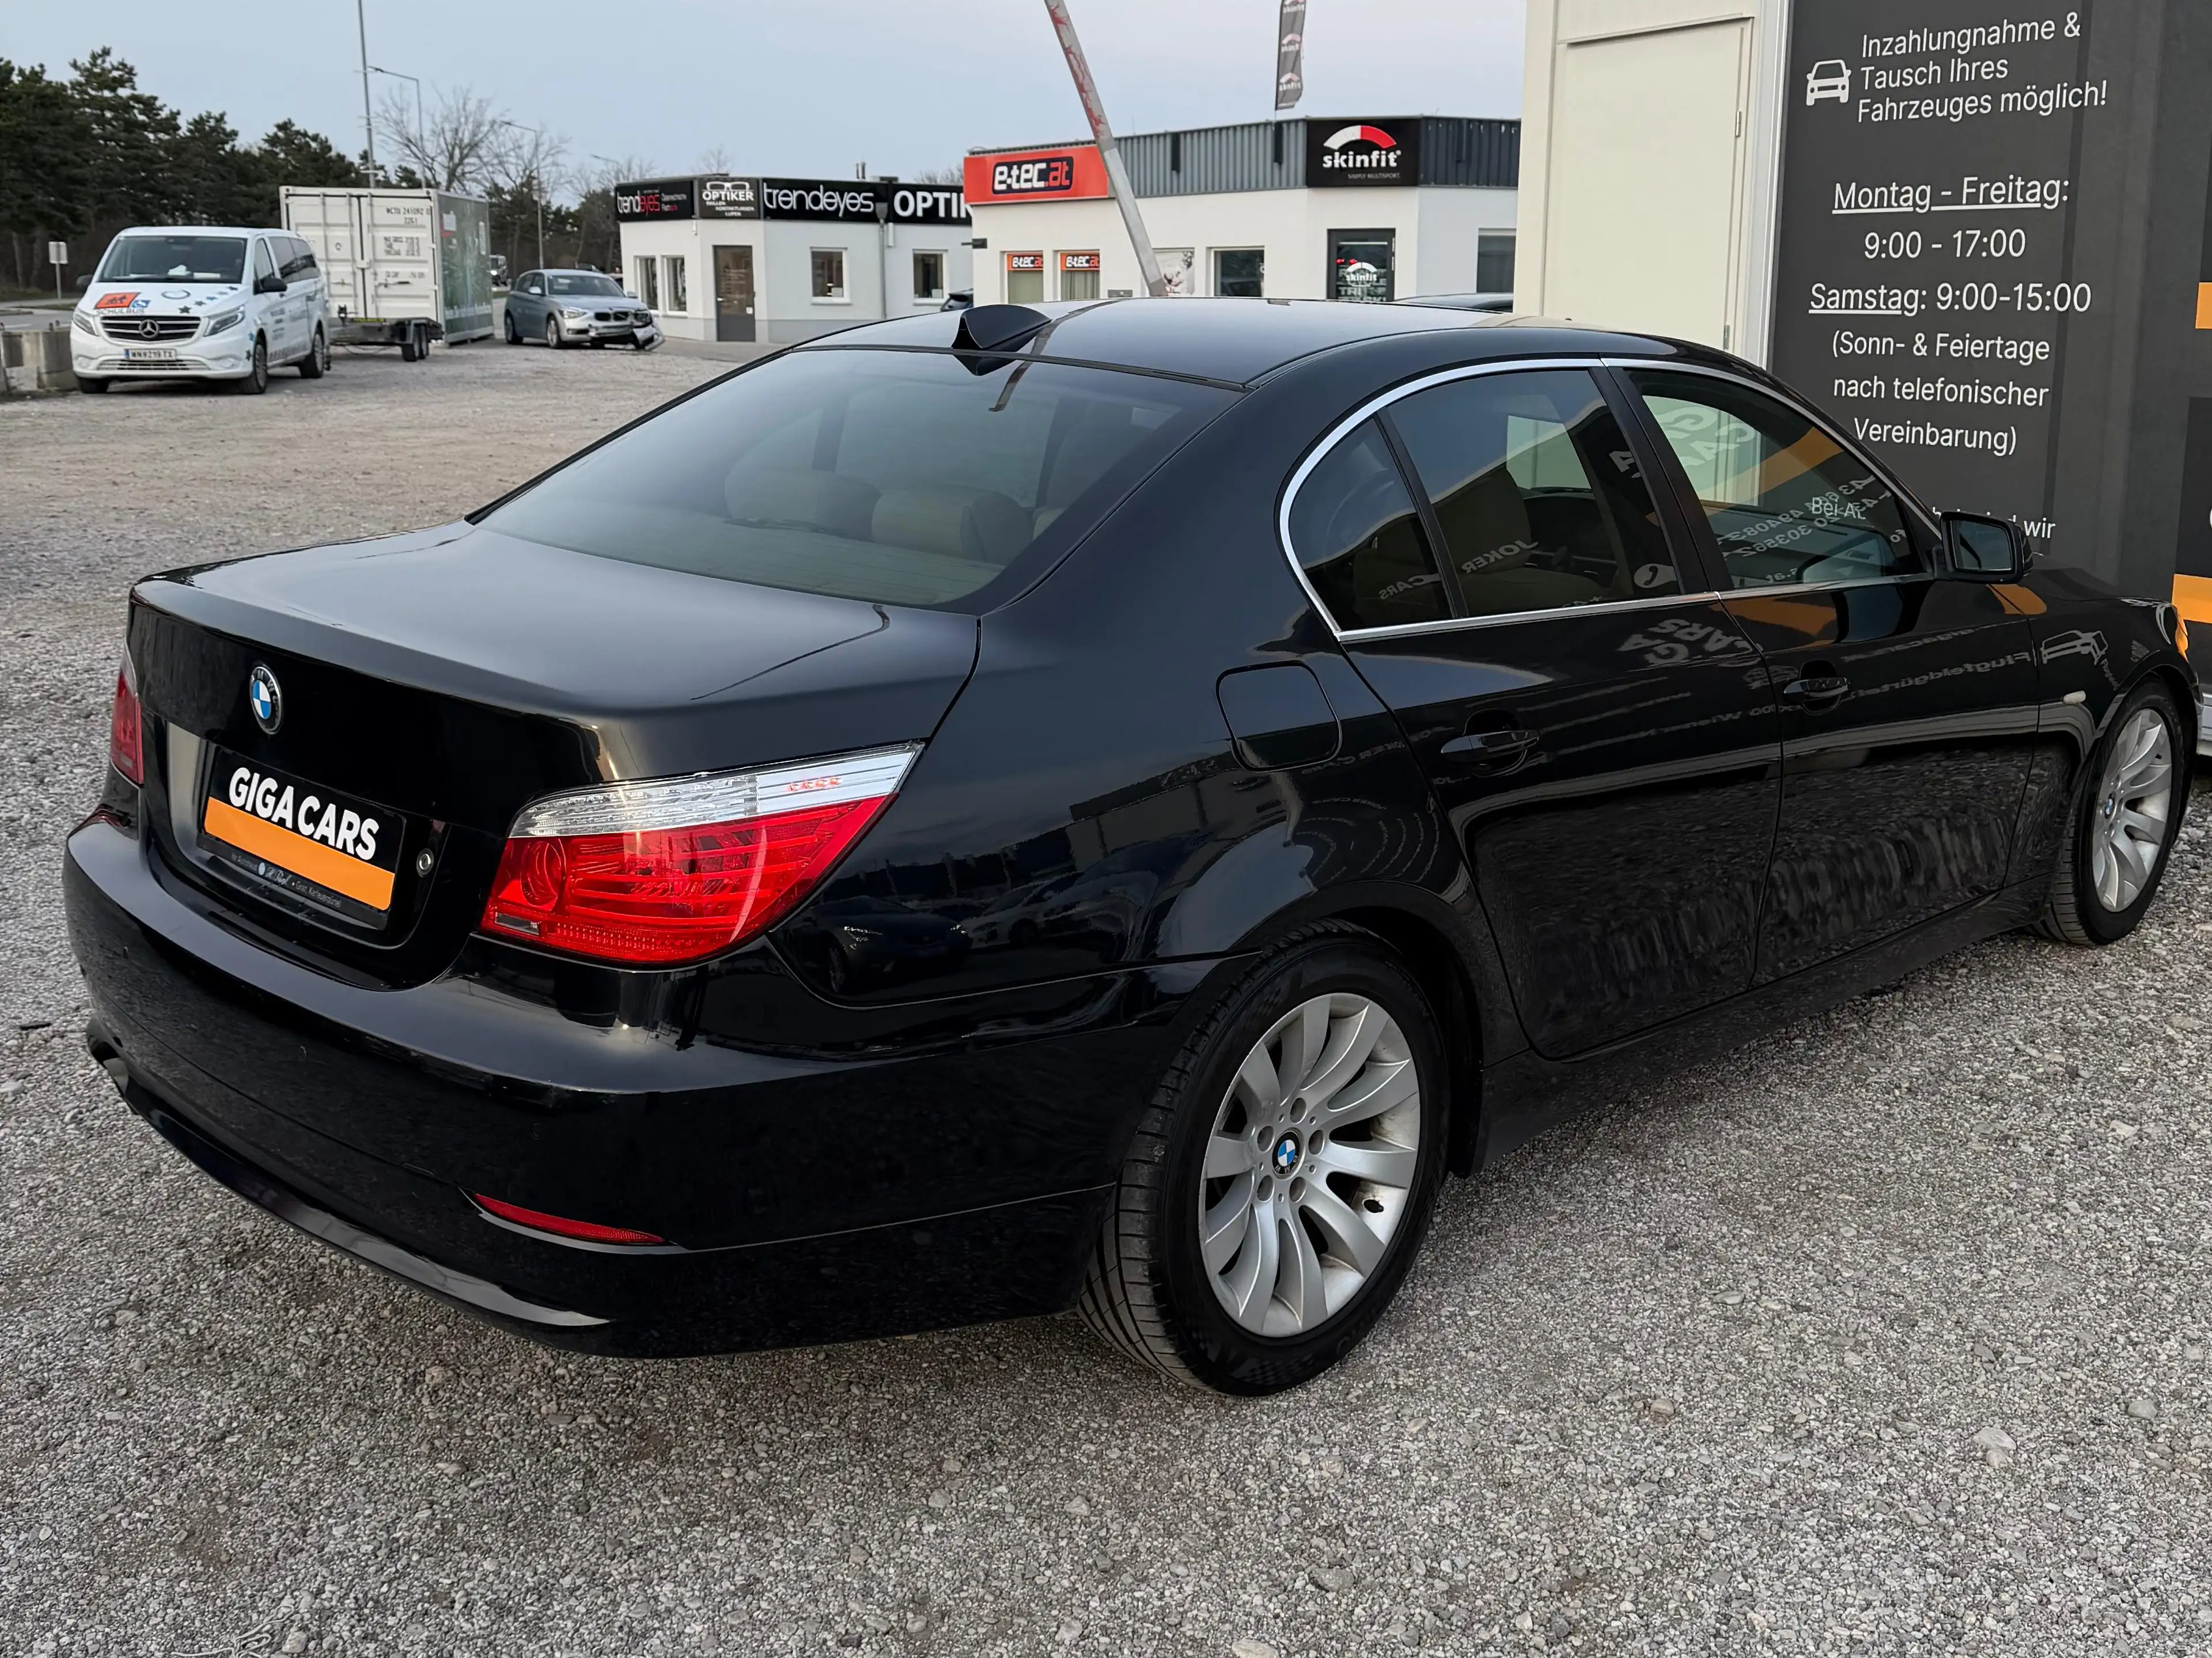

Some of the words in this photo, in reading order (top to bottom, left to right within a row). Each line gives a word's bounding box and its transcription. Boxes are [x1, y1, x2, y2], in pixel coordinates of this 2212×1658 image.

[1862, 19, 2056, 57] Inzahlungnahme
[2064, 12, 2081, 37] &
[1861, 60, 1941, 90] Tausch
[1949, 58, 2009, 82] Ihres
[1858, 94, 1992, 123] Fahrzeuges
[2000, 79, 2107, 116] möglich!
[1323, 150, 1397, 168] skinfit
[617, 191, 660, 216] trendeyes
[702, 191, 754, 200] OPTIKER
[763, 182, 874, 218] trendeyes
[1833, 181, 1931, 213] Montag
[1961, 174, 2070, 210] Freitag:
[1863, 231, 1922, 259] 9:00
[1953, 229, 2027, 257] 17:00
[1809, 283, 1927, 317] Samstag:
[1936, 283, 2092, 312] 9:00-15:00
[1833, 330, 1906, 358] (Sonn-
[1912, 332, 1928, 356] &
[1936, 333, 2050, 366] Feiertage
[1834, 375, 1886, 399] nach
[1893, 377, 2050, 407] telefonischer
[1854, 417, 2017, 457] Vereinbarung)
[2024, 517, 2056, 539] wir
[229, 767, 294, 829] GIGA
[297, 795, 380, 860] CARS
